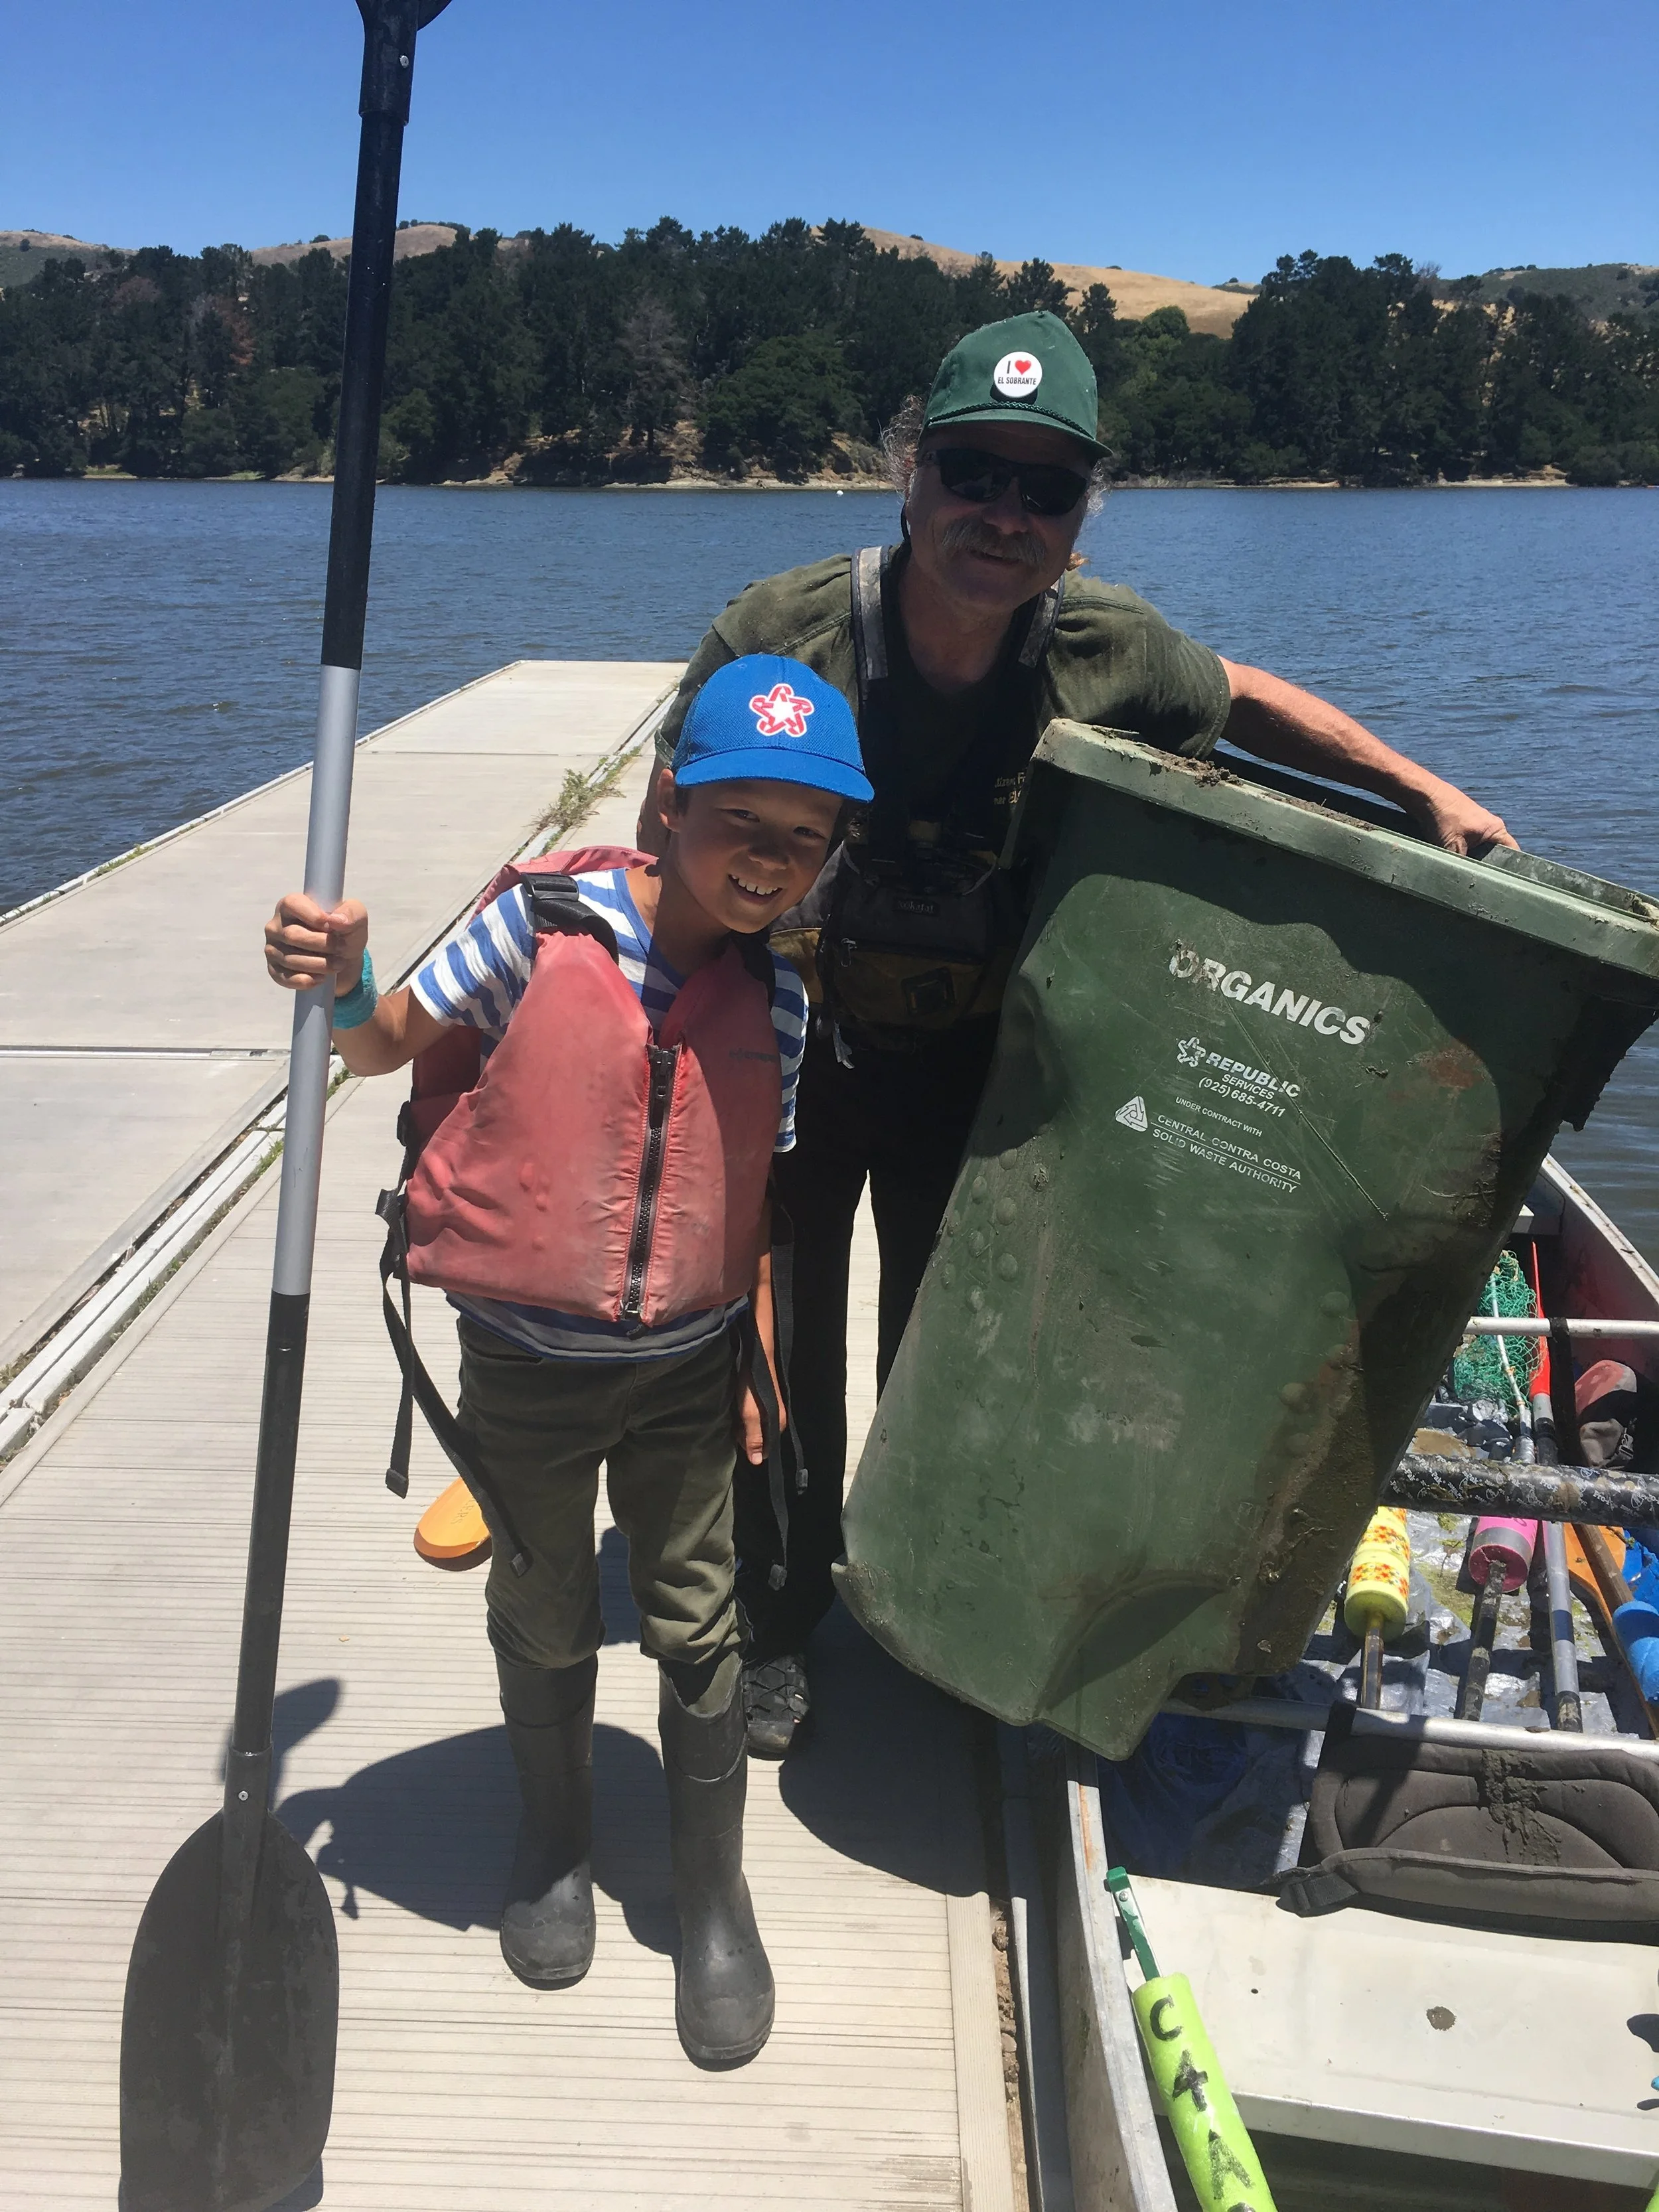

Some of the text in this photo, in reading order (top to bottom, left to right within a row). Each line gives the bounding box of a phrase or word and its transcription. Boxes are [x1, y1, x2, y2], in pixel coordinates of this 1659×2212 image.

[1005, 376, 1037, 385] SOBRANTE
[1006, 360, 1011, 374] I
[1169, 949, 1371, 1045] ORGANICS
[1205, 1052, 1301, 1097] REPUBLIC
[1222, 1073, 1275, 1100] SERVICES
[1175, 1096, 1263, 1138] UNDER CONTRACT WITH
[1198, 1076, 1286, 1118] (925) 685-4711
[1152, 1128, 1297, 1194] SOLID WASTE AUTHORITY
[1157, 1114, 1301, 1180] CENTRAL CONTRA COSTA
